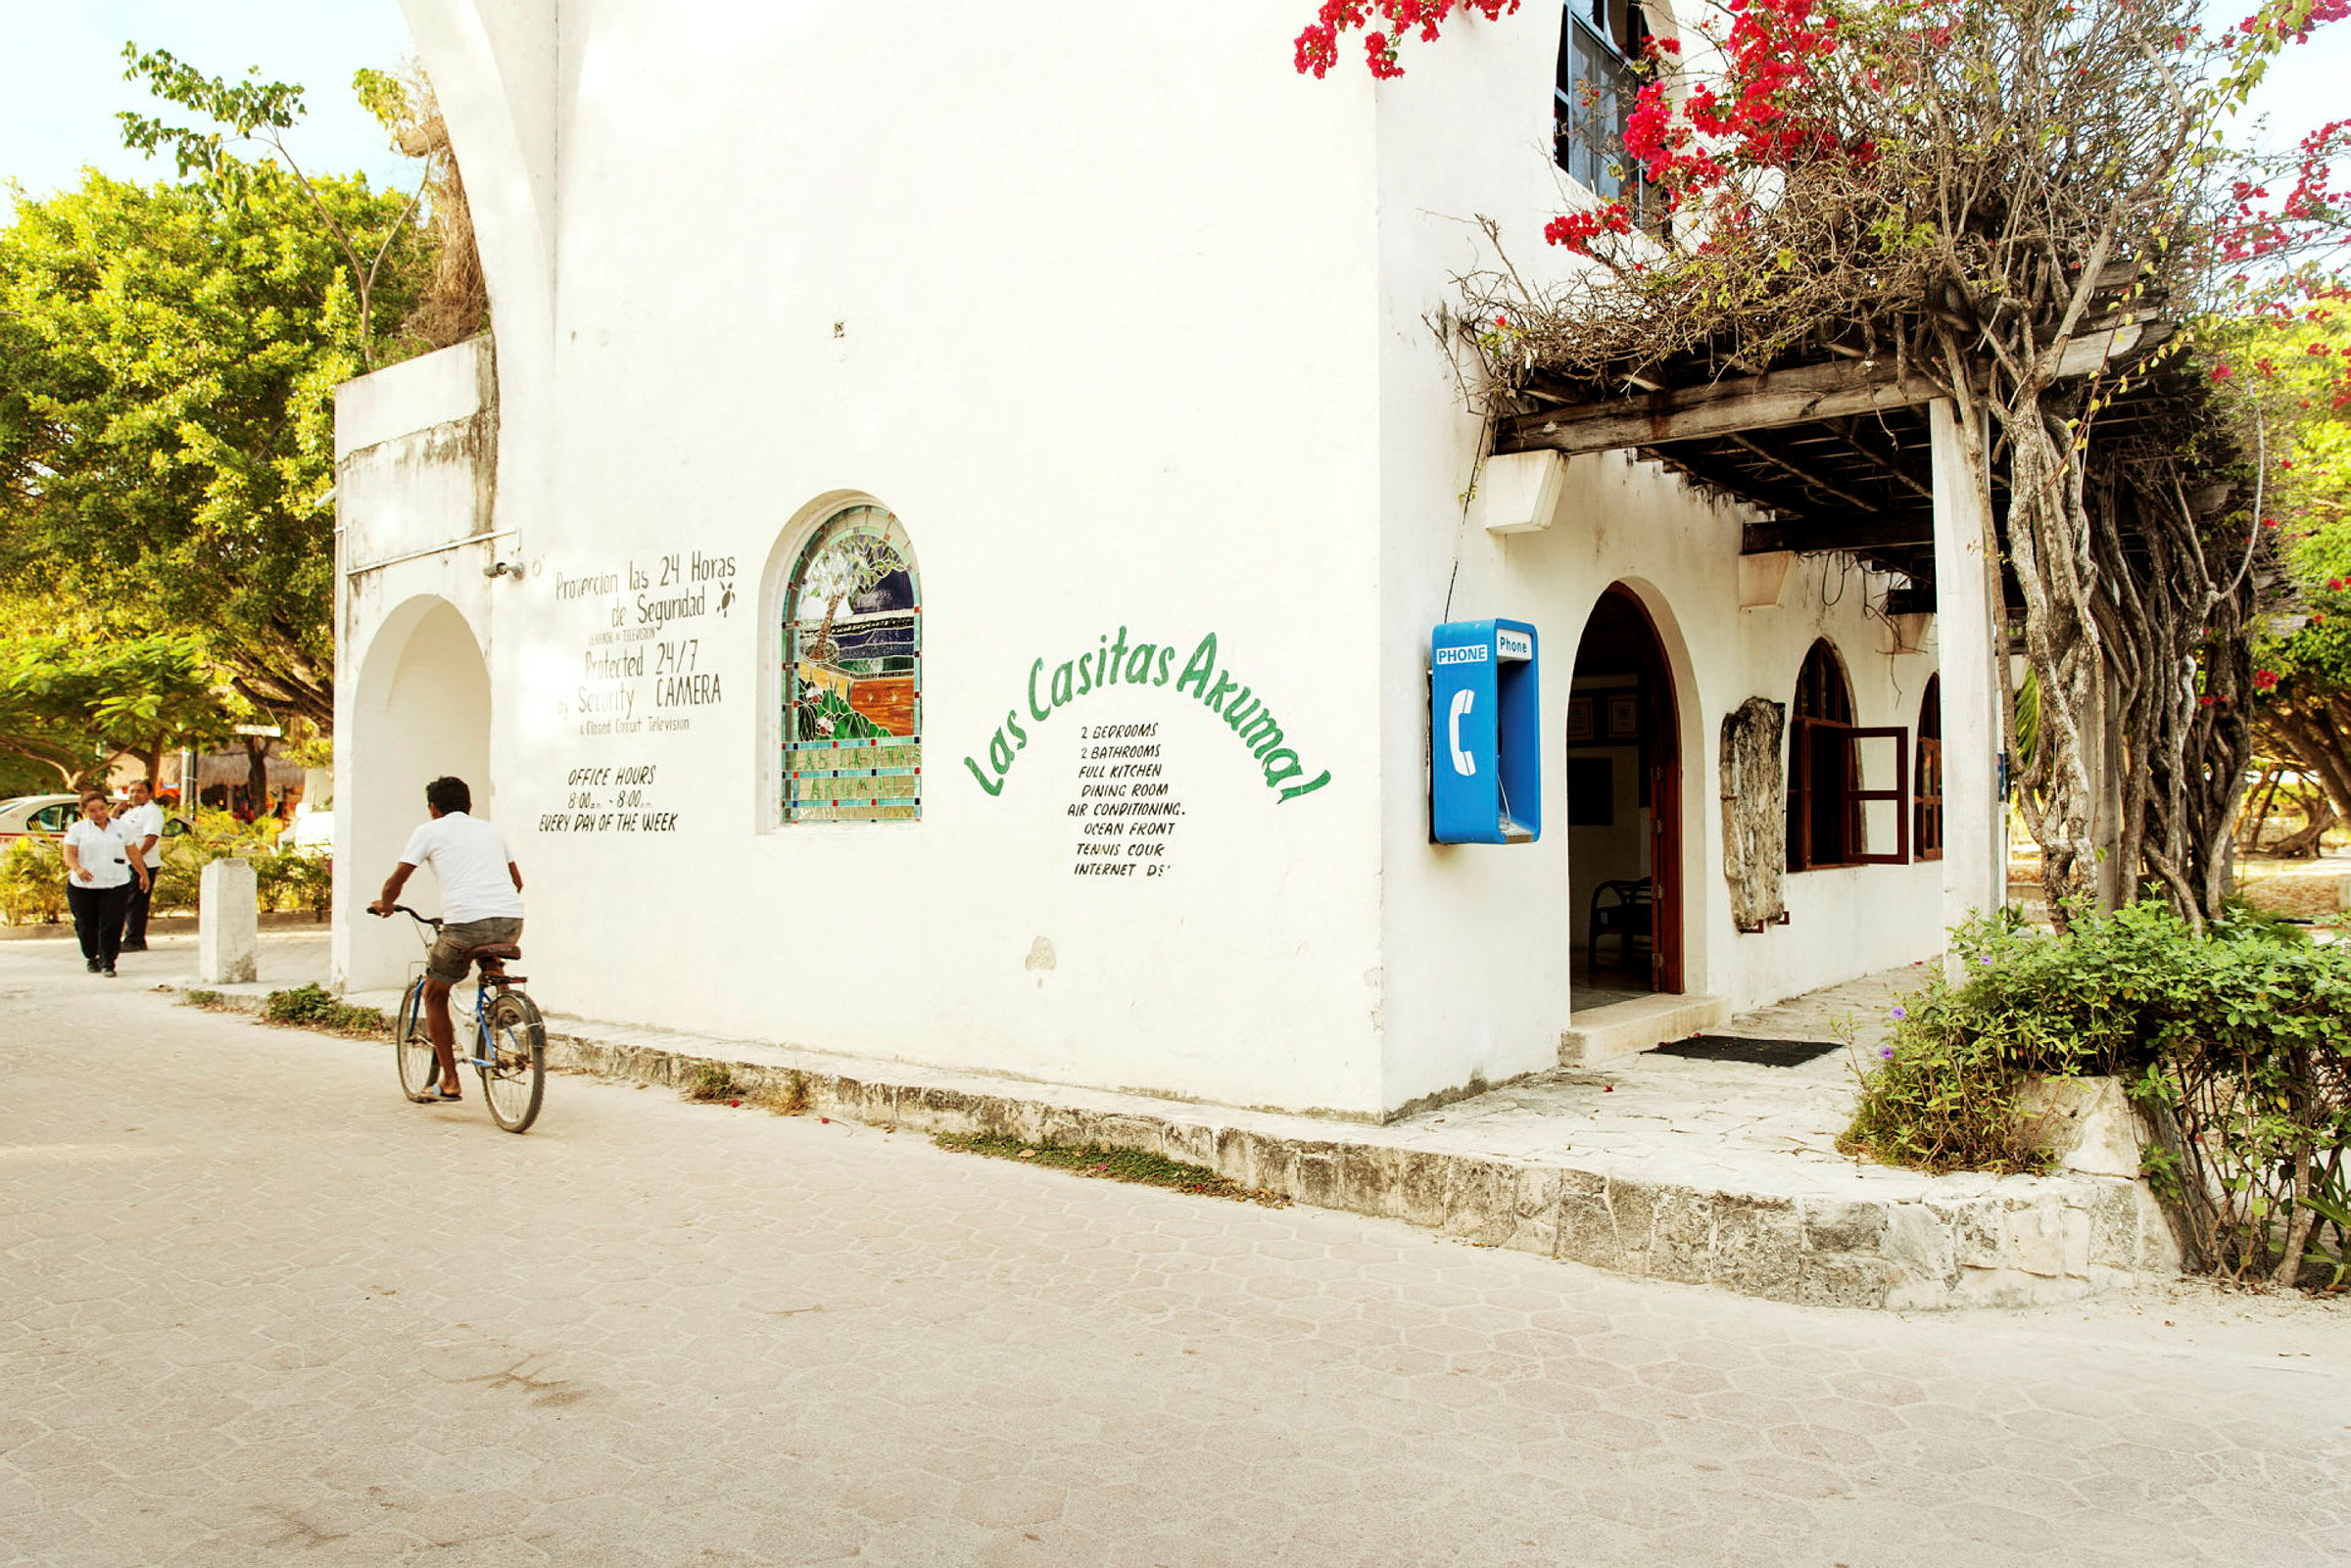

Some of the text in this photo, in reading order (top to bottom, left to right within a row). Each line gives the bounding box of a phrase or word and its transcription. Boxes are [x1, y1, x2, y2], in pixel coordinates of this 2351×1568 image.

[629, 559, 649, 592] las
[659, 552, 680, 587] 24
[691, 549, 737, 583] Horas
[611, 585, 705, 630] de Seguridad
[1500, 636, 1527, 654] Phone
[655, 639, 698, 676] 24/7
[1438, 646, 1487, 663] PHONE
[655, 673, 723, 708] CAMERA
[1028, 625, 1176, 722] Casitas
[1176, 631, 1331, 805] Akumal
[648, 715, 690, 733] Television
[1080, 722, 1159, 739] 2 BEDROOMS
[1080, 743, 1162, 760] 2 BATHROOMS
[568, 764, 656, 785] OFFICE HOURS
[1079, 763, 1162, 779] FULL KITCHEN
[1081, 783, 1169, 798] DINING ROOM
[1068, 802, 1186, 817] AIR CONDITIONING.
[539, 812, 679, 832] EVERY DAY OF THE WEEK
[1083, 822, 1176, 836] OCEAN FRONT
[1077, 842, 1121, 856] TENNIS
[1074, 863, 1136, 877] INTERNET
